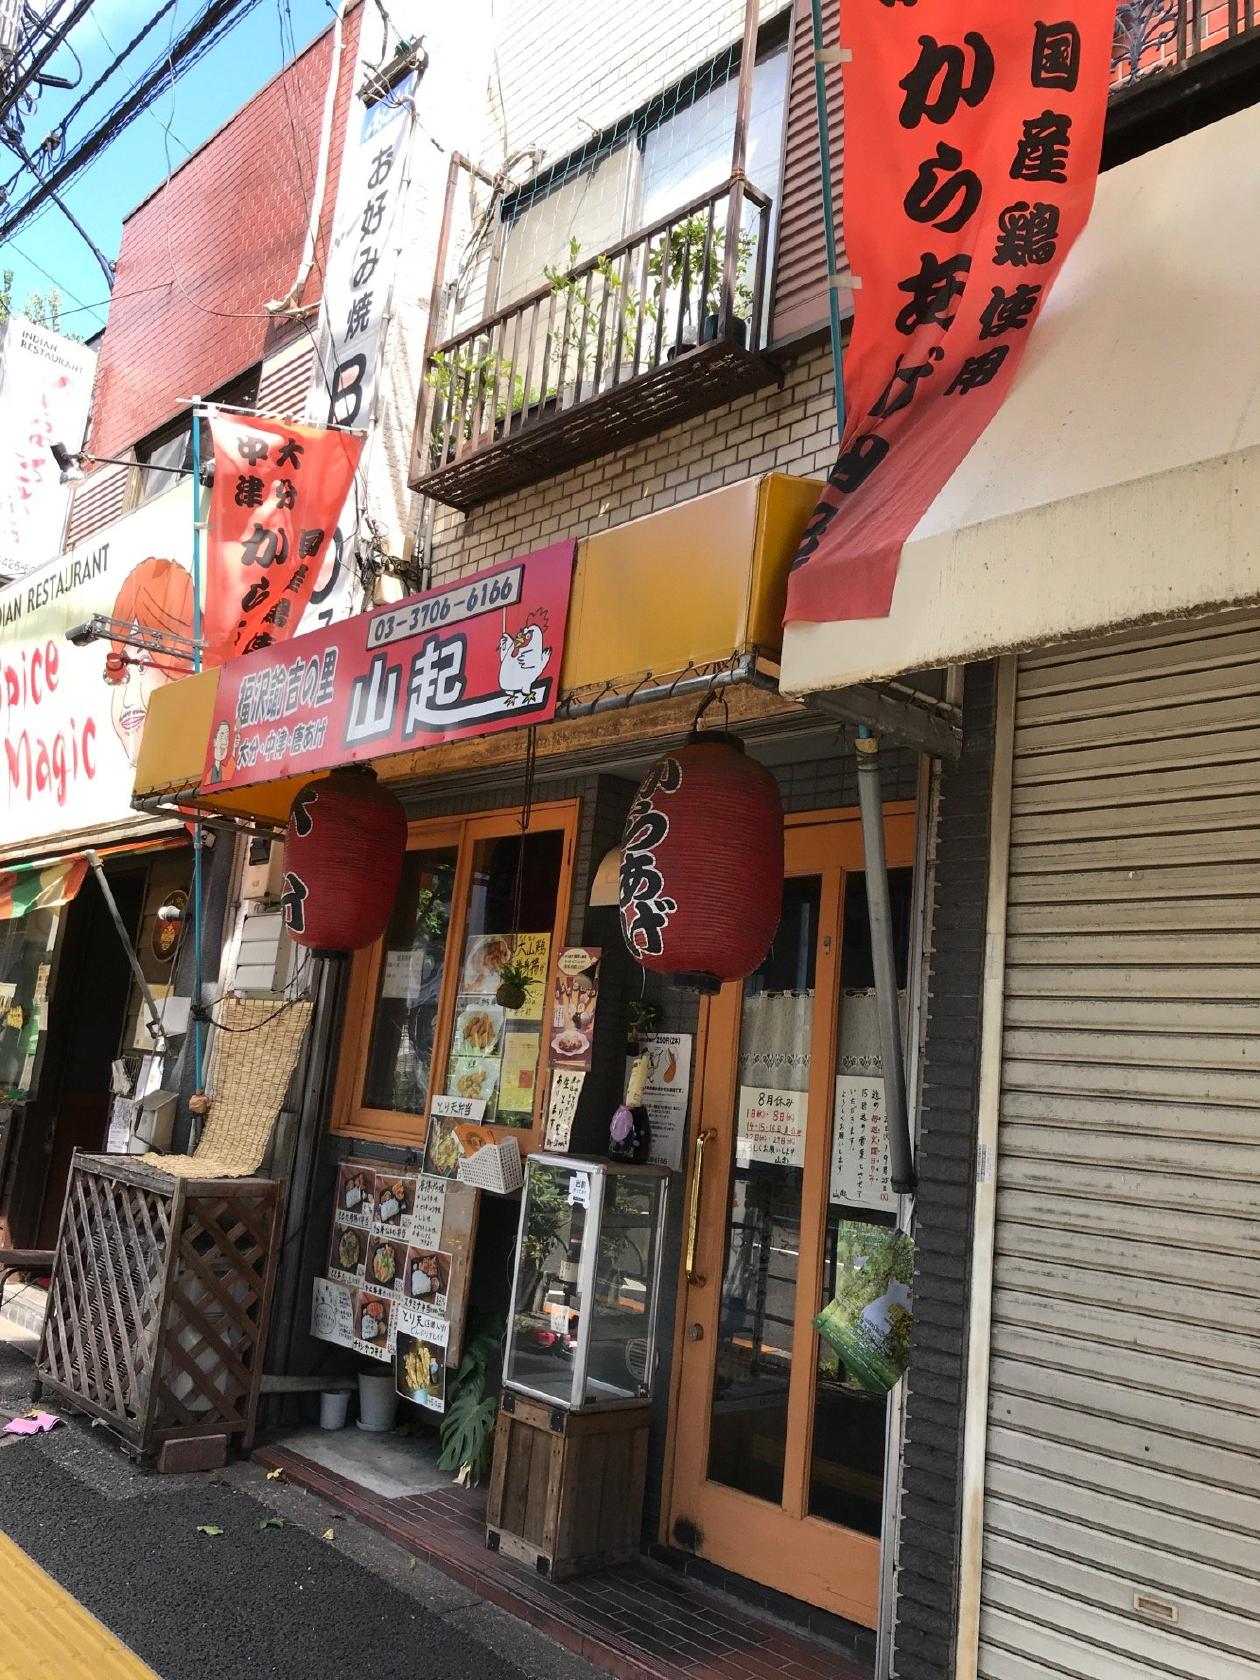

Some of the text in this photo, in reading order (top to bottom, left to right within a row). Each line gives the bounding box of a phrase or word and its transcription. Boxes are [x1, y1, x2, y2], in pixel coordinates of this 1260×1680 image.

[344, 147, 394, 344] お好み焼
[943, 19, 1081, 397] 国産鶏使用
[20, 340, 84, 374] RESTAURANT
[22, 330, 58, 352] INDIAN
[0, 543, 110, 628] IAN RESTAURANT
[374, 576, 513, 641] 03-3706-6166
[1, 639, 59, 722] pice
[346, 635, 554, 746] 山起
[5, 717, 97, 807] Magic
[620, 758, 693, 960] からあげ
[758, 1092, 793, 1108] 8月休み
